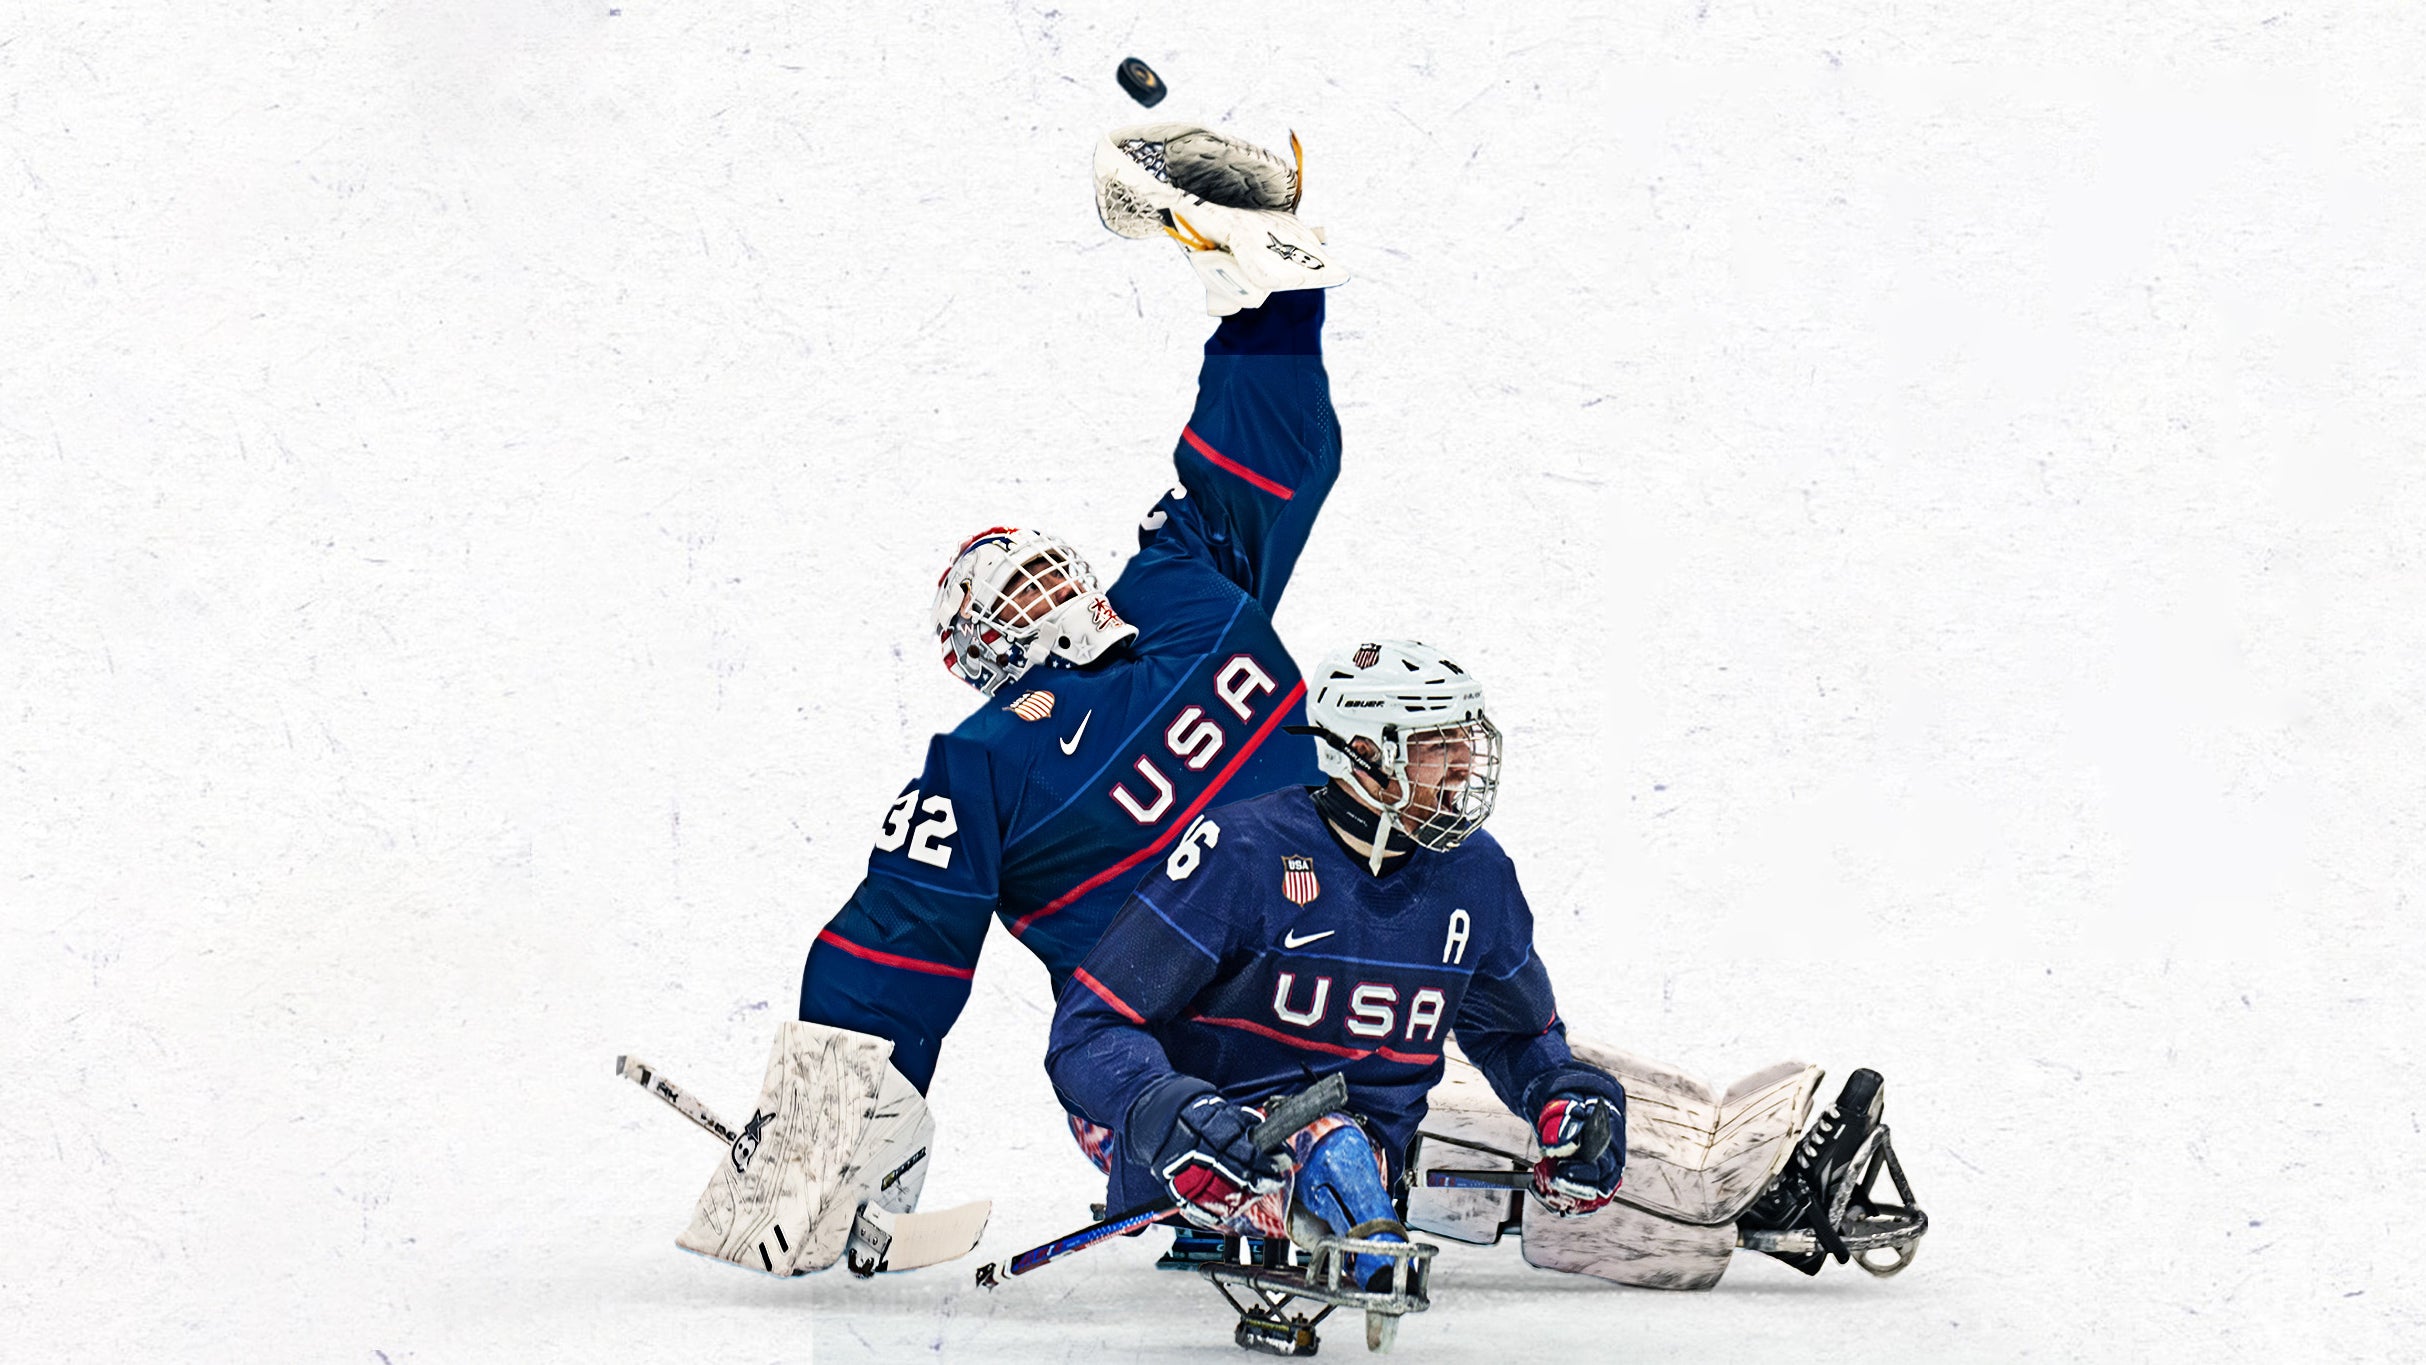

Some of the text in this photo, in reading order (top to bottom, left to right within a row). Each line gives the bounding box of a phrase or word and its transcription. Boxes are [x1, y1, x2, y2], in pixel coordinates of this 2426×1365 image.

[1109, 653, 1279, 825] USA
[875, 789, 958, 869] 32
[1288, 860, 1310, 871] USA
[1442, 908, 1471, 965] A
[1272, 971, 1446, 1042] USA
